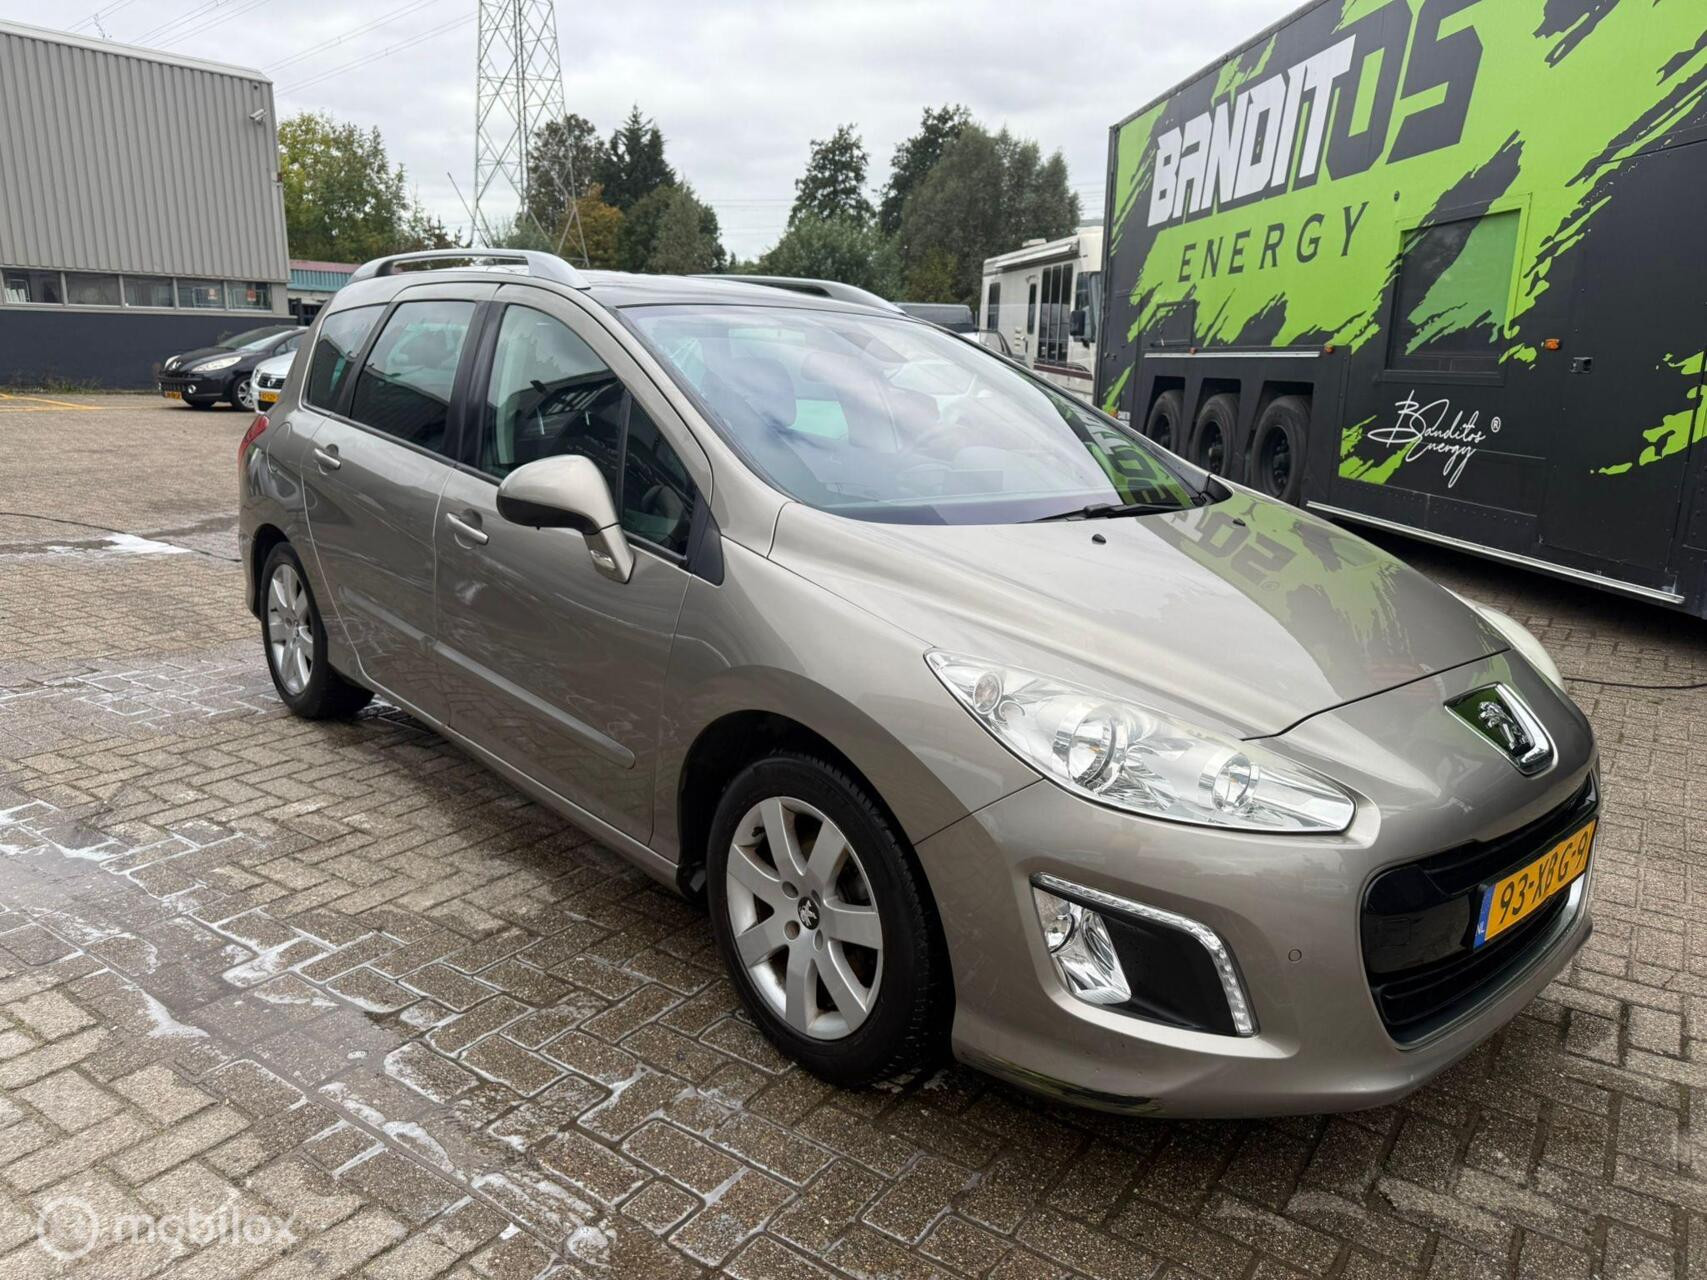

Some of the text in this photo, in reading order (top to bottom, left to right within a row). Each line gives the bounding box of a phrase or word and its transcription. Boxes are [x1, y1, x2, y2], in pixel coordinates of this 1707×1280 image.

[1177, 201, 1370, 283] ENERGY
[1367, 389, 1487, 448] Banditos
[1405, 433, 1477, 488] Energy
[1499, 831, 1589, 926] 93-XBG-9
